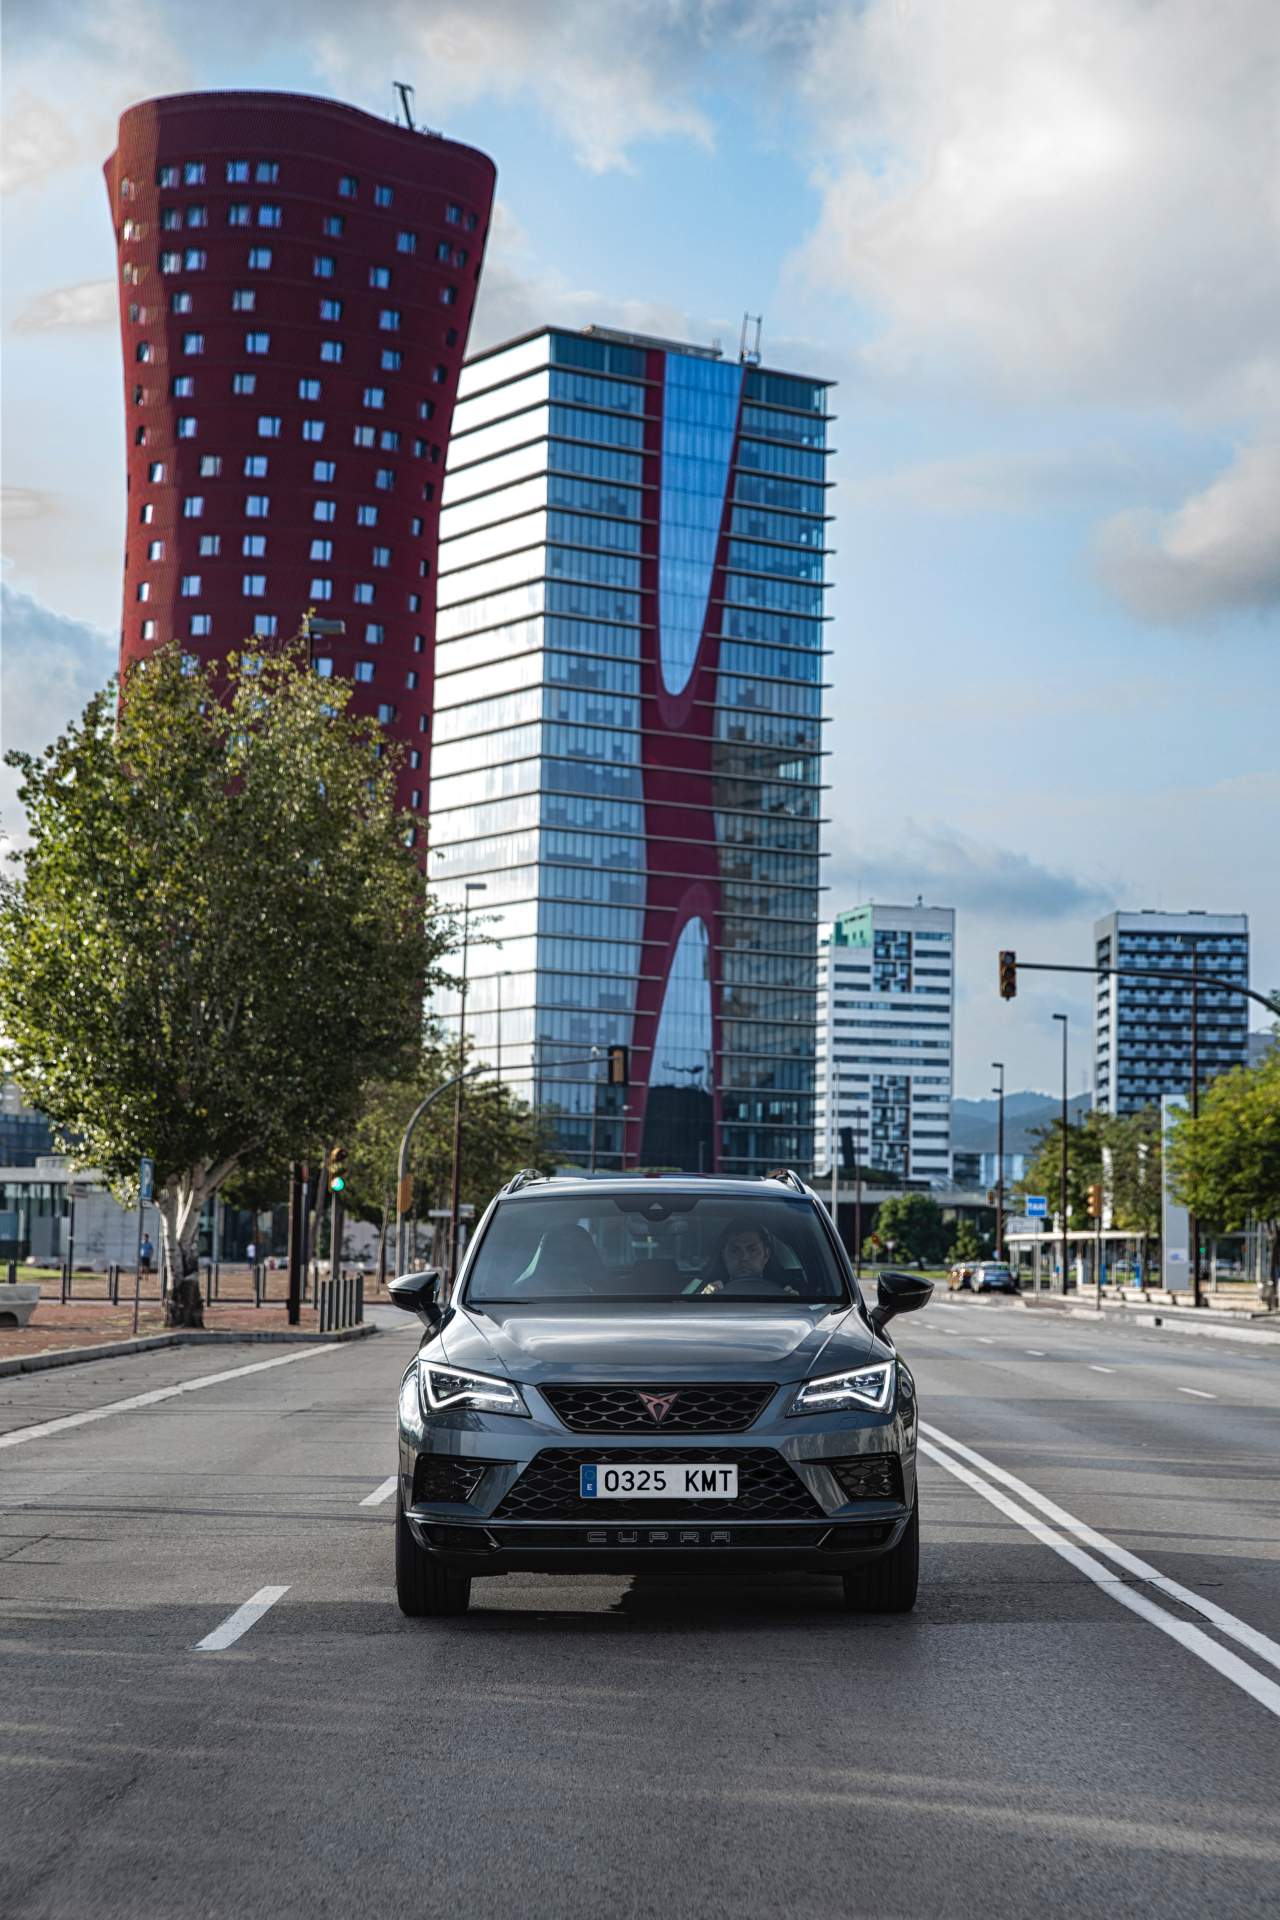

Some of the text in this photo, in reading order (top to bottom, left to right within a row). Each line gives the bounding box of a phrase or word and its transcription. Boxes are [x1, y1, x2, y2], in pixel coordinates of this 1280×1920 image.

[586, 1483, 593, 1491] E
[604, 1470, 733, 1492] 0325 KMT
[587, 1531, 731, 1543] CUPRA
